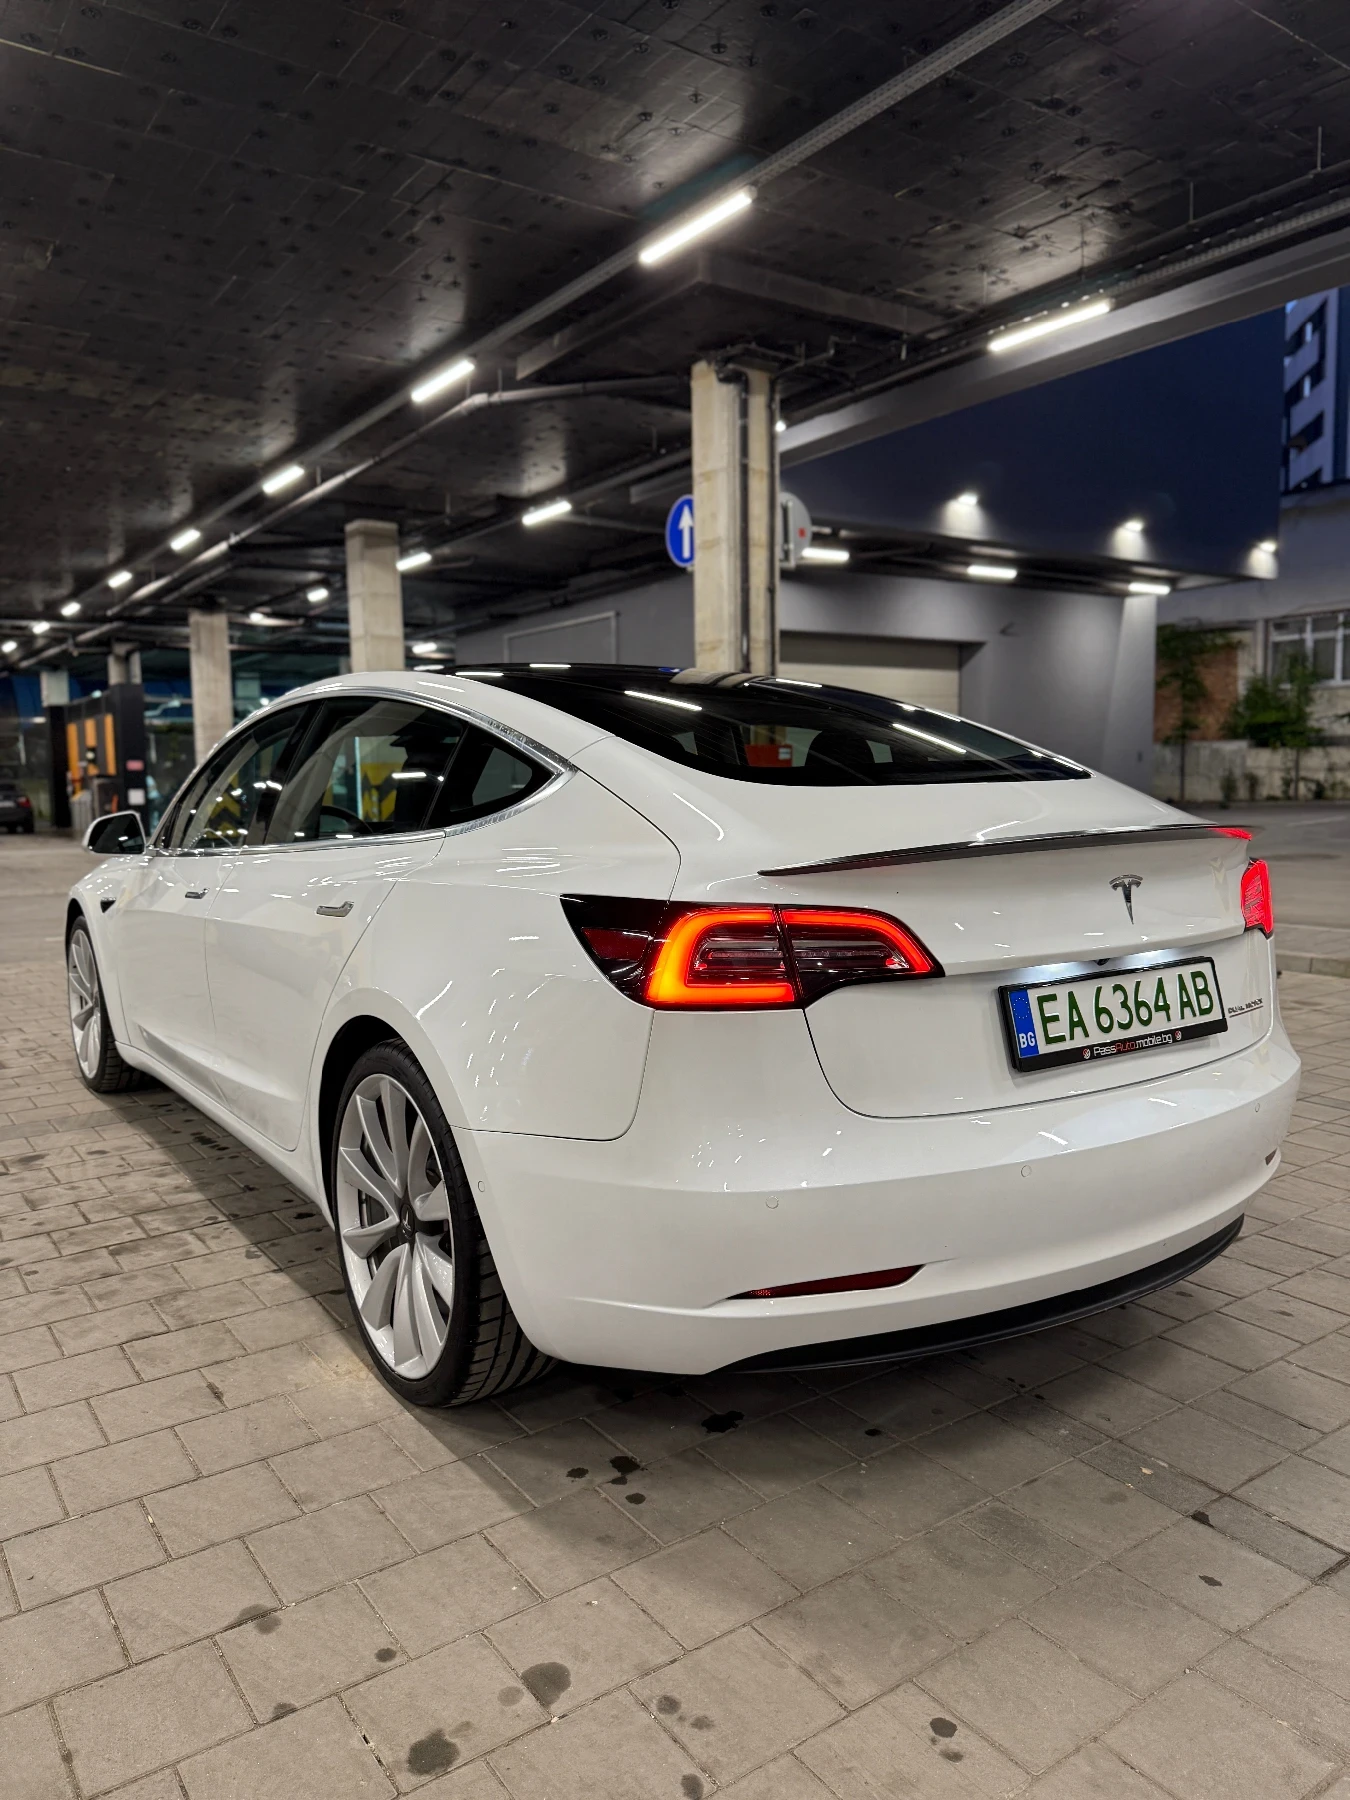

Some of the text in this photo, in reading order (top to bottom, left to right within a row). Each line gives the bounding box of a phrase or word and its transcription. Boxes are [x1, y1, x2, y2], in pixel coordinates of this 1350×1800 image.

[1036, 970, 1214, 1046] EA 6364 AB
[1019, 1032, 1036, 1049] BG
[1093, 1033, 1173, 1057] PassAuto.mobile.bg
